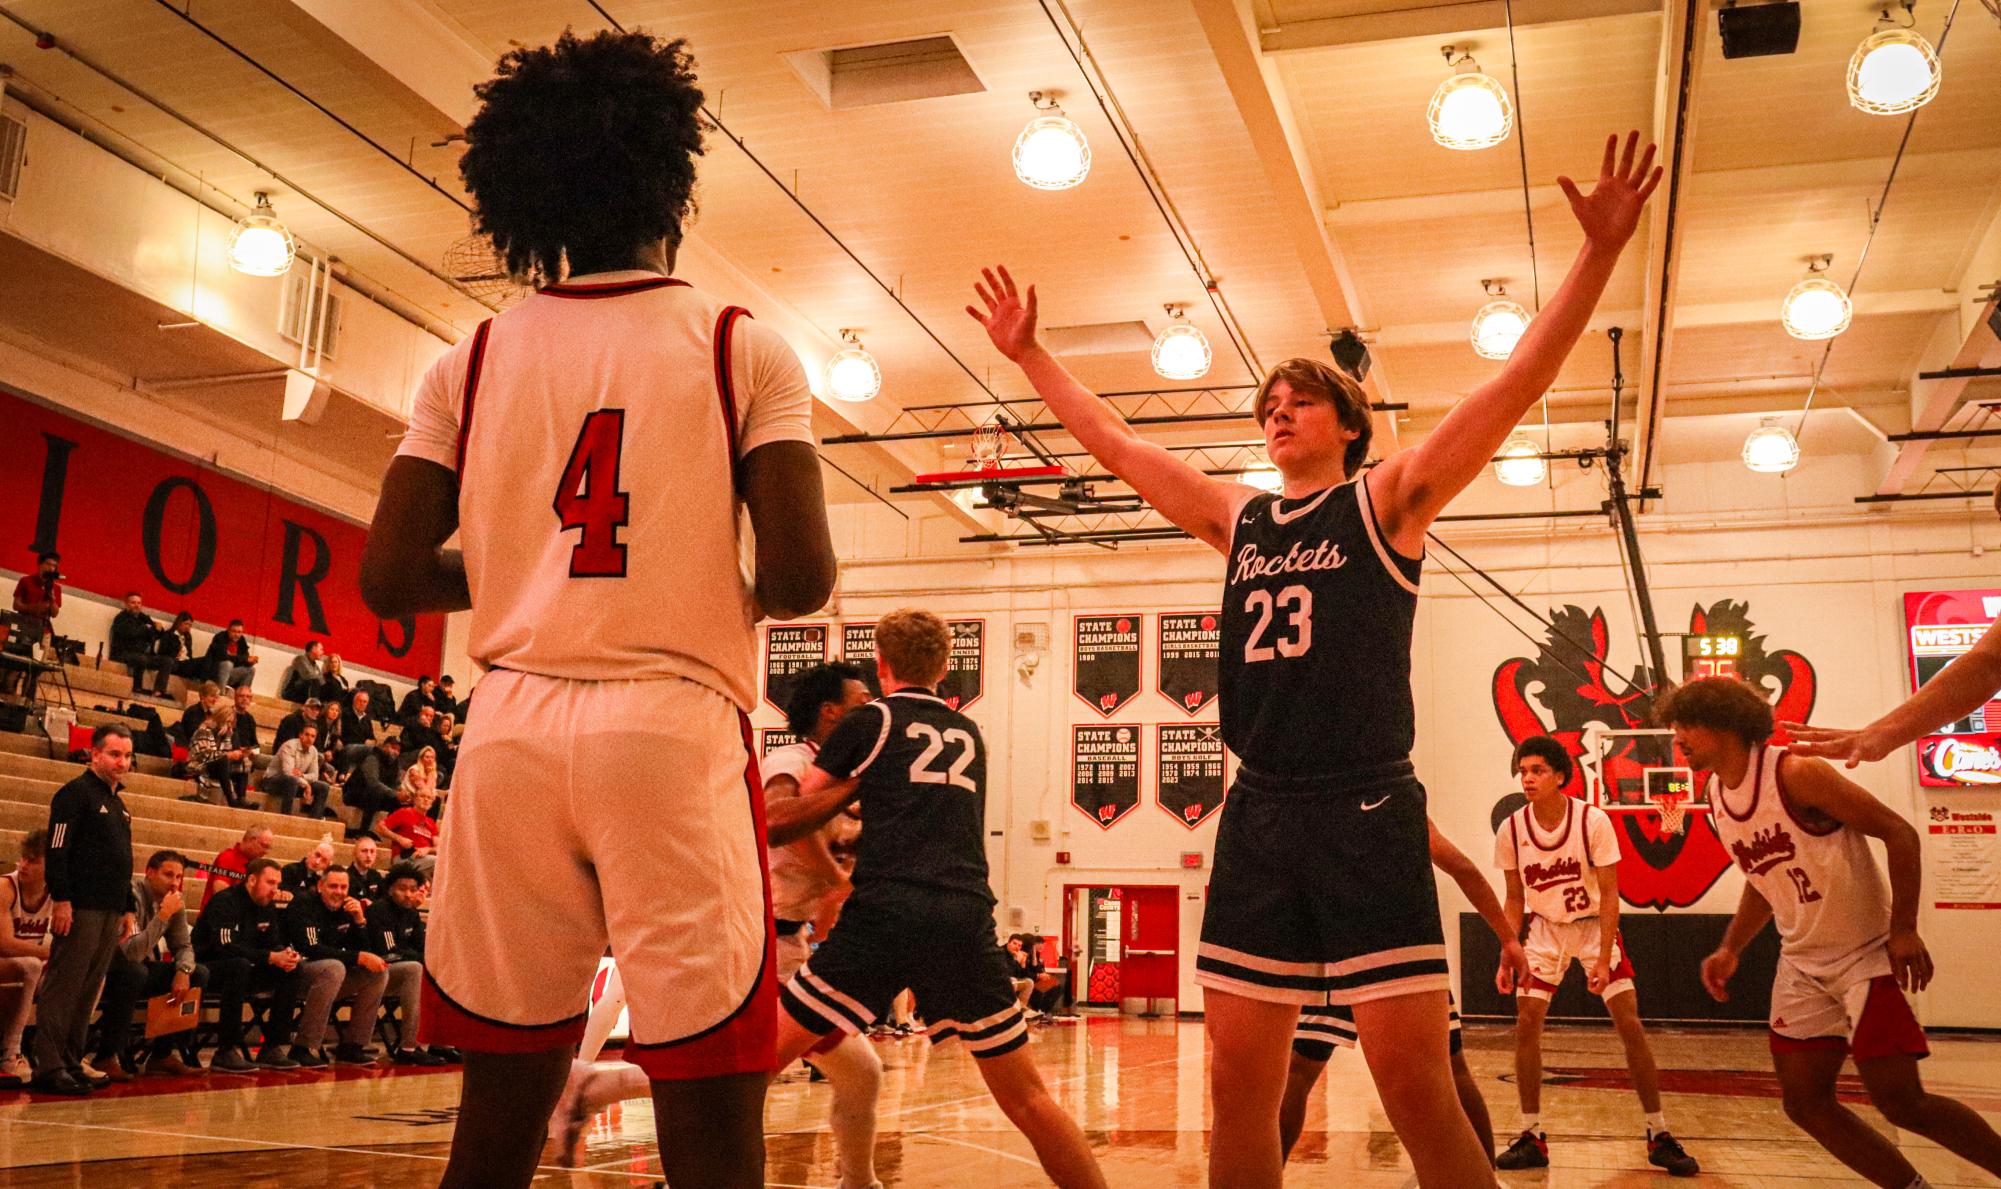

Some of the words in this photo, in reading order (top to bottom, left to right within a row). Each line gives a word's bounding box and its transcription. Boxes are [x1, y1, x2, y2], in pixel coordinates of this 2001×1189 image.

[553, 409, 630, 578] 4
[1231, 540, 1347, 585] Rockets
[1079, 622, 1112, 632] STATE
[1163, 619, 1197, 629] STATE
[1245, 585, 1312, 663] 23
[771, 632, 801, 641] STATE
[1079, 633, 1137, 643] CHAMPIONS
[1163, 631, 1220, 641] CHAMPIONS
[1915, 629, 1986, 646] WESTS
[770, 642, 823, 652] CHAMPIONS
[951, 638, 979, 647] PIONS
[766, 735, 796, 744] STATE
[1077, 731, 1111, 741] STATE
[1162, 730, 1196, 740] STATE
[1077, 743, 1136, 753] CHAMPIONS
[1162, 742, 1222, 752] CHAMPIONS
[906, 722, 976, 793] 22
[199, 863, 228, 876] PLEASE
[1787, 867, 1822, 903] 12
[1563, 886, 1591, 913] 23
